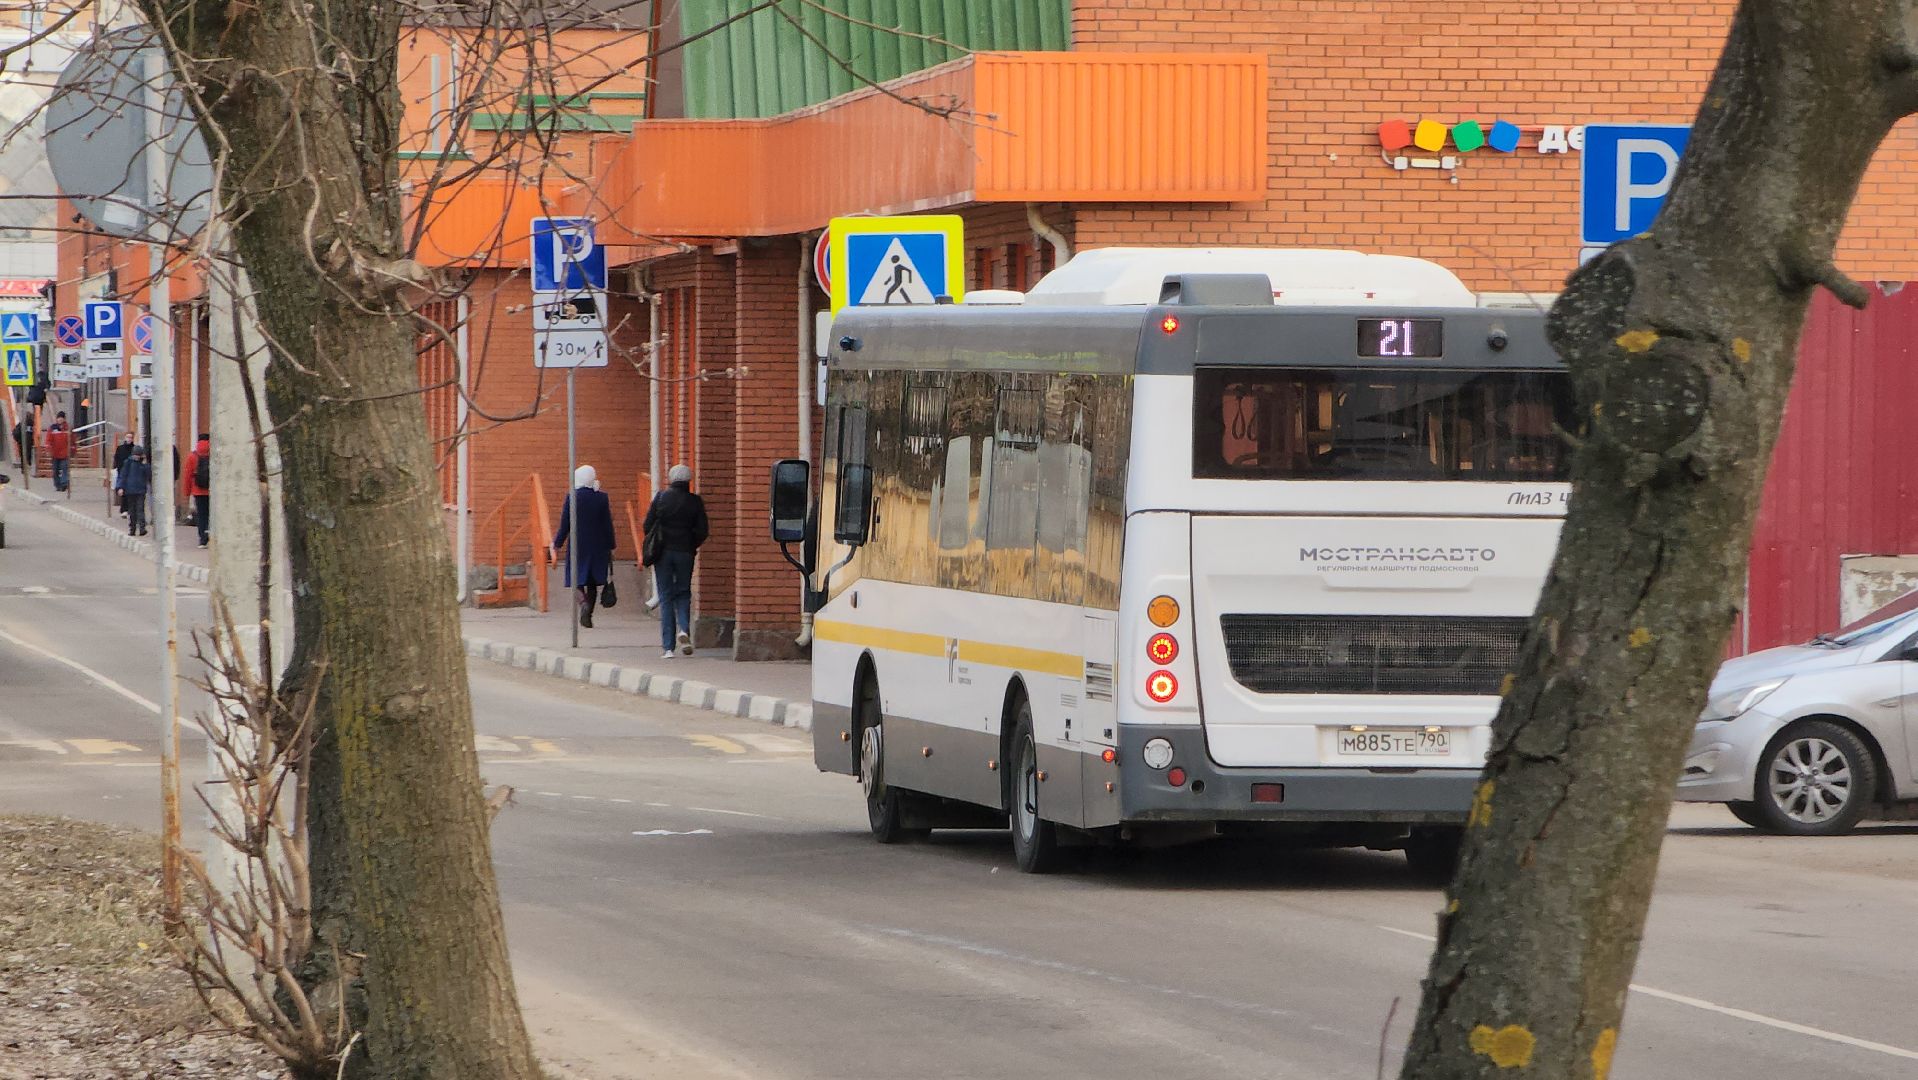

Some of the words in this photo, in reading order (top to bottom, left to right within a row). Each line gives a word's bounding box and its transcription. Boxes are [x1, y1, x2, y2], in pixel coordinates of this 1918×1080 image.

[1615, 138, 1680, 232] P
[552, 227, 593, 283] P
[94, 305, 117, 336] P
[1380, 320, 1412, 356] 21
[1299, 548, 1496, 562] МОСТРАНСАВТО
